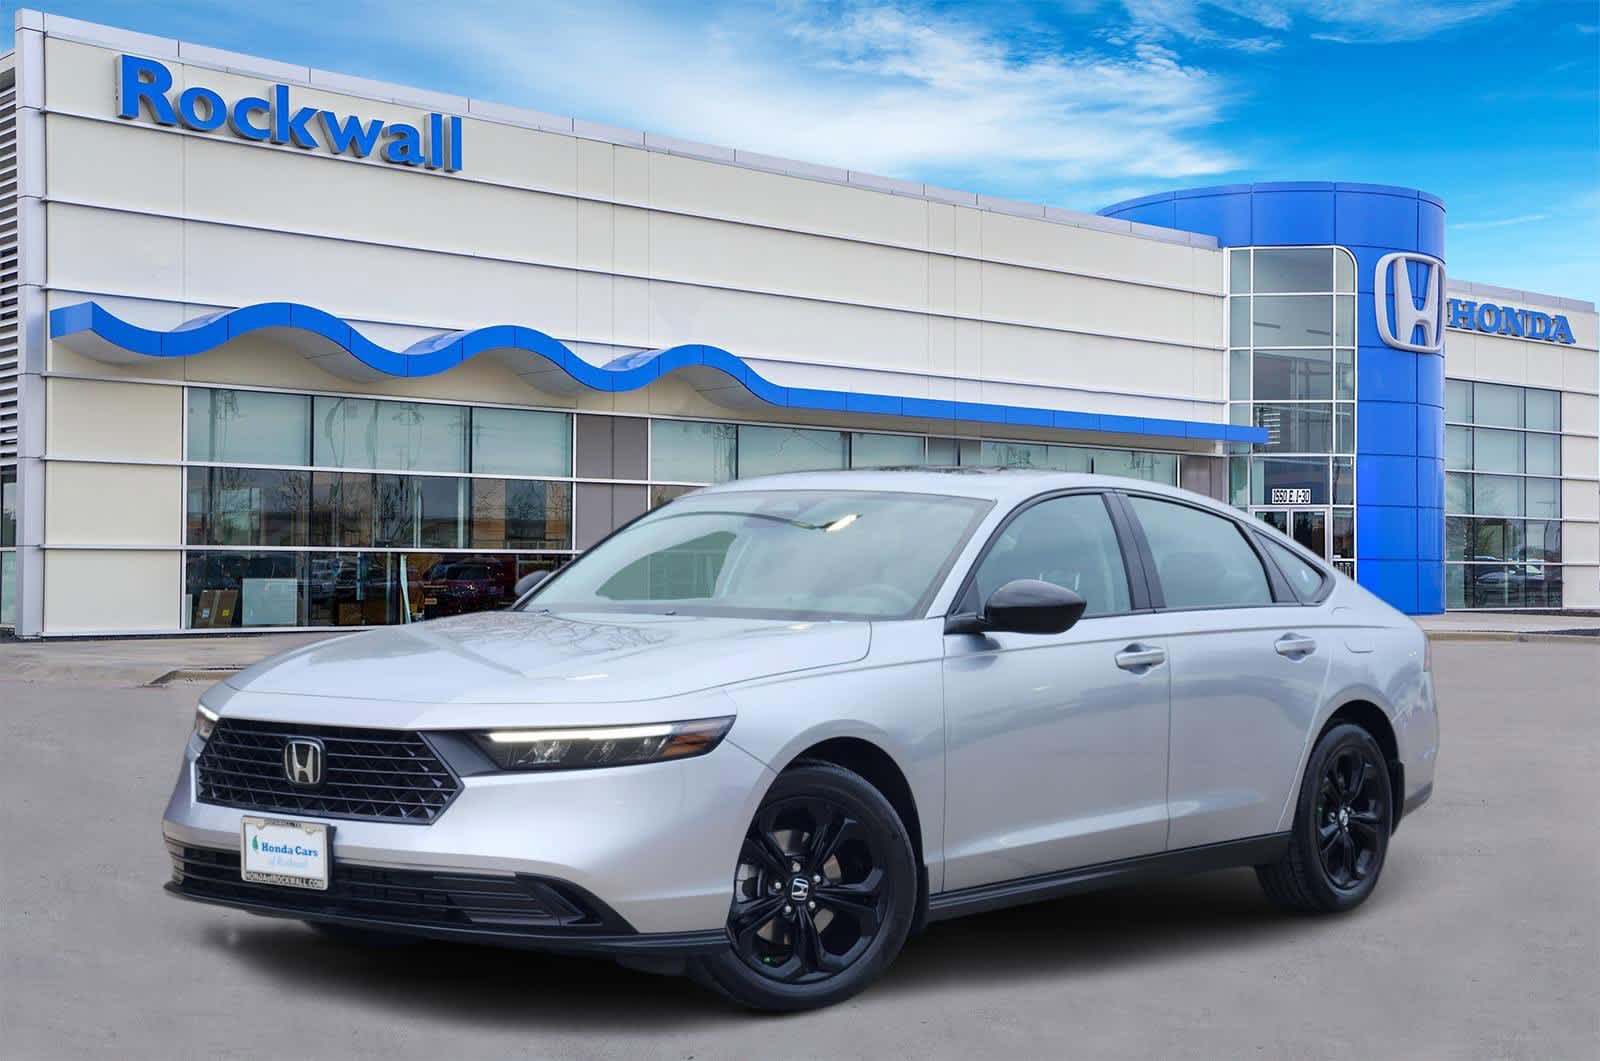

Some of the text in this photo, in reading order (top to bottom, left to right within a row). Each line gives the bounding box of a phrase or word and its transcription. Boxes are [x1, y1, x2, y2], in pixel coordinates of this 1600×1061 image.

[116, 54, 463, 173] Rockwall
[1447, 298, 1577, 345] HONDA
[261, 842, 319, 857] Honda Cars
